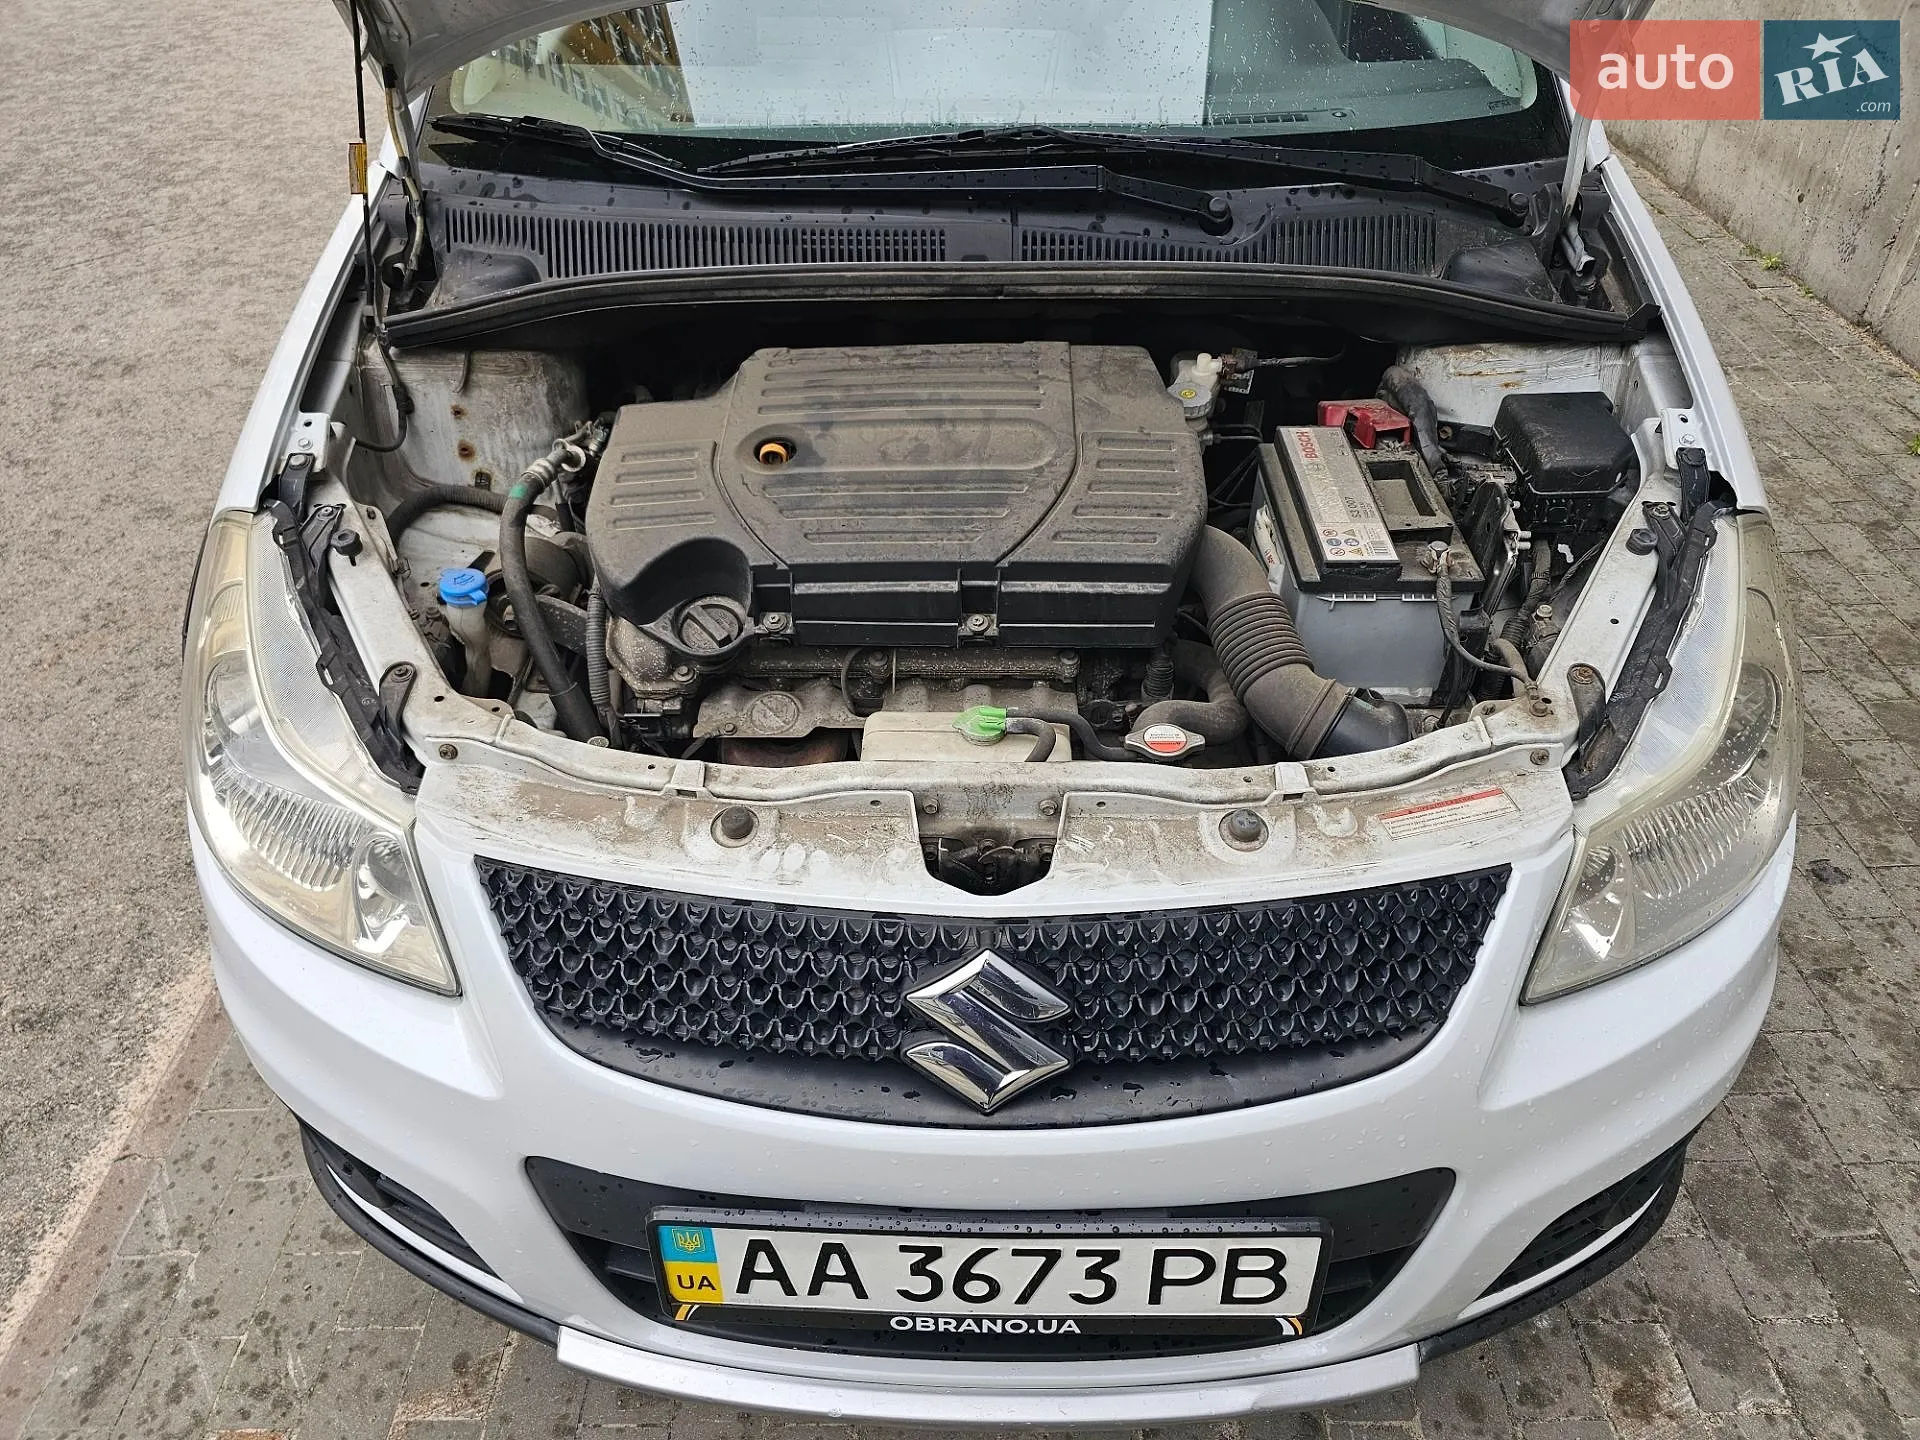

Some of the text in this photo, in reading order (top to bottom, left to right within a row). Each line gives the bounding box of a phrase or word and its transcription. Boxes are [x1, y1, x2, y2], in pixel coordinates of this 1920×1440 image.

[1296, 431, 1318, 459] BOSCH
[676, 1274, 717, 1291] UA
[736, 1238, 1287, 1305] AA 3673 PB
[890, 1316, 1082, 1335] OBRANO.UA
